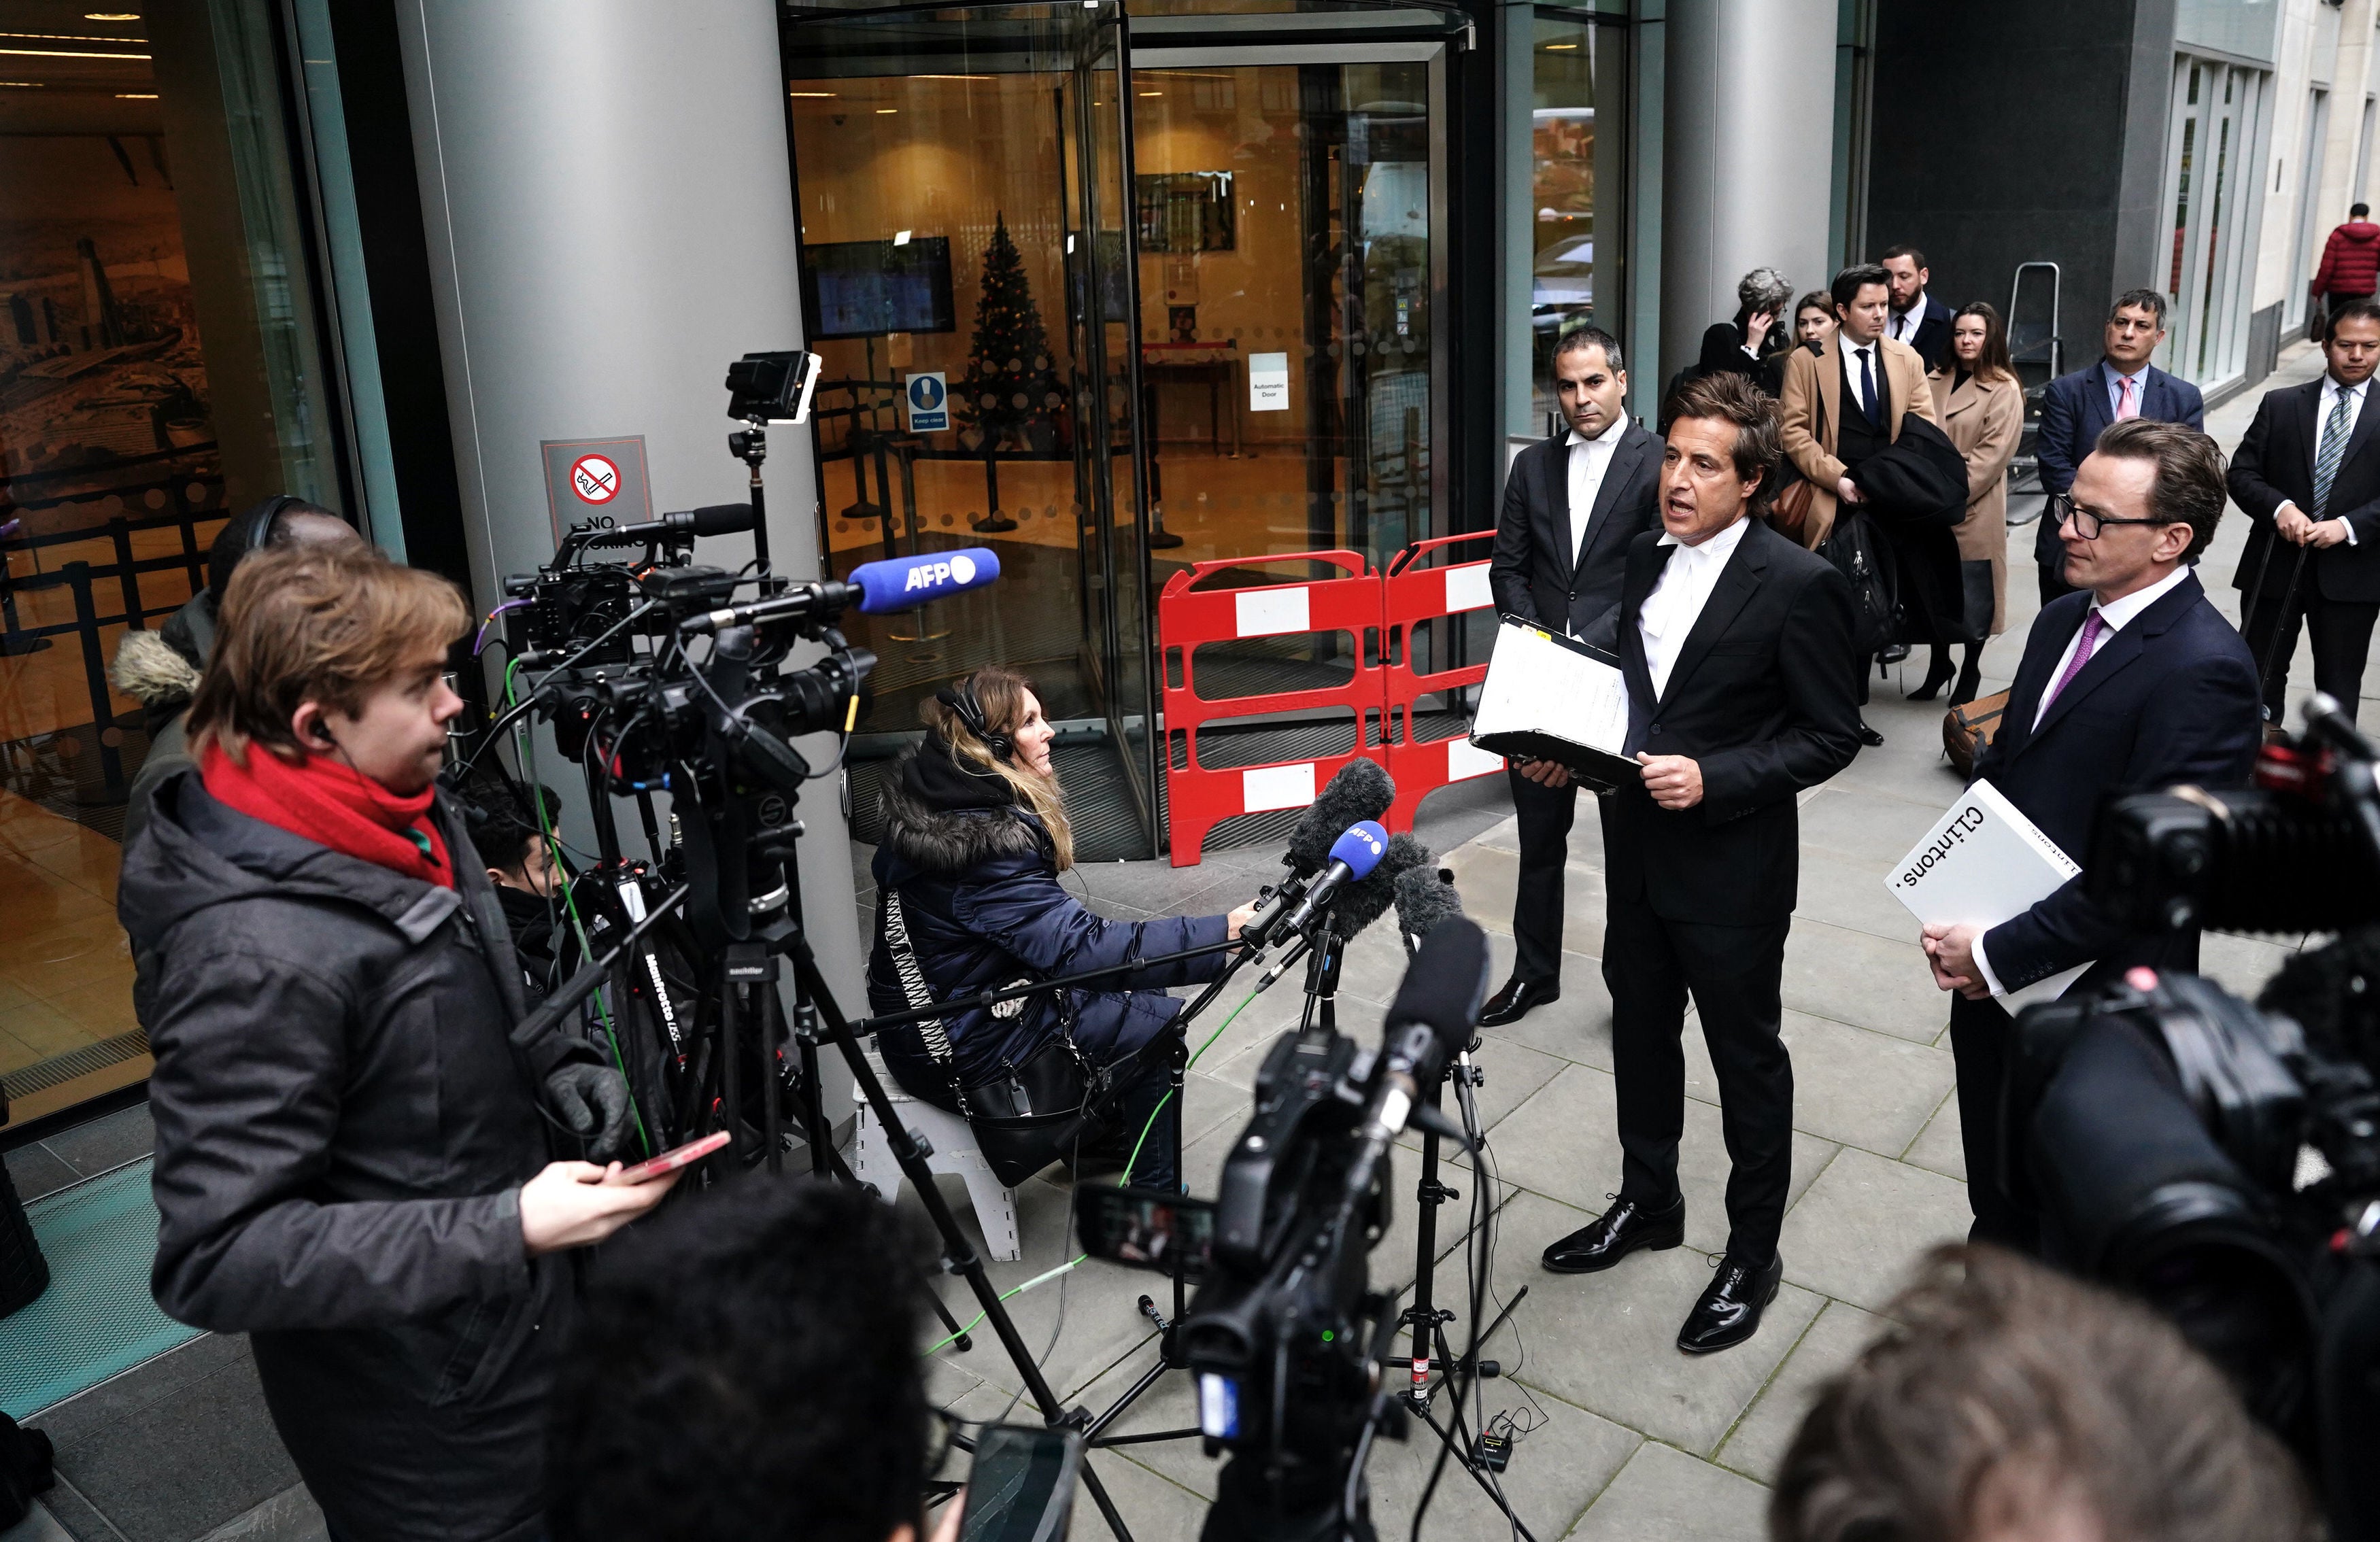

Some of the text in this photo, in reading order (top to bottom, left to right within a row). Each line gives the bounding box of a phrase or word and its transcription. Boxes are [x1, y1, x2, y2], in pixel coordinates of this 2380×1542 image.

[587, 515, 615, 530] NO
[904, 562, 951, 592] AFP
[1348, 827, 1374, 842] AFP
[1896, 806, 1984, 889] Clintons.
[2027, 823, 2079, 875] lintons.
[645, 953, 674, 1021] Manfrotto
